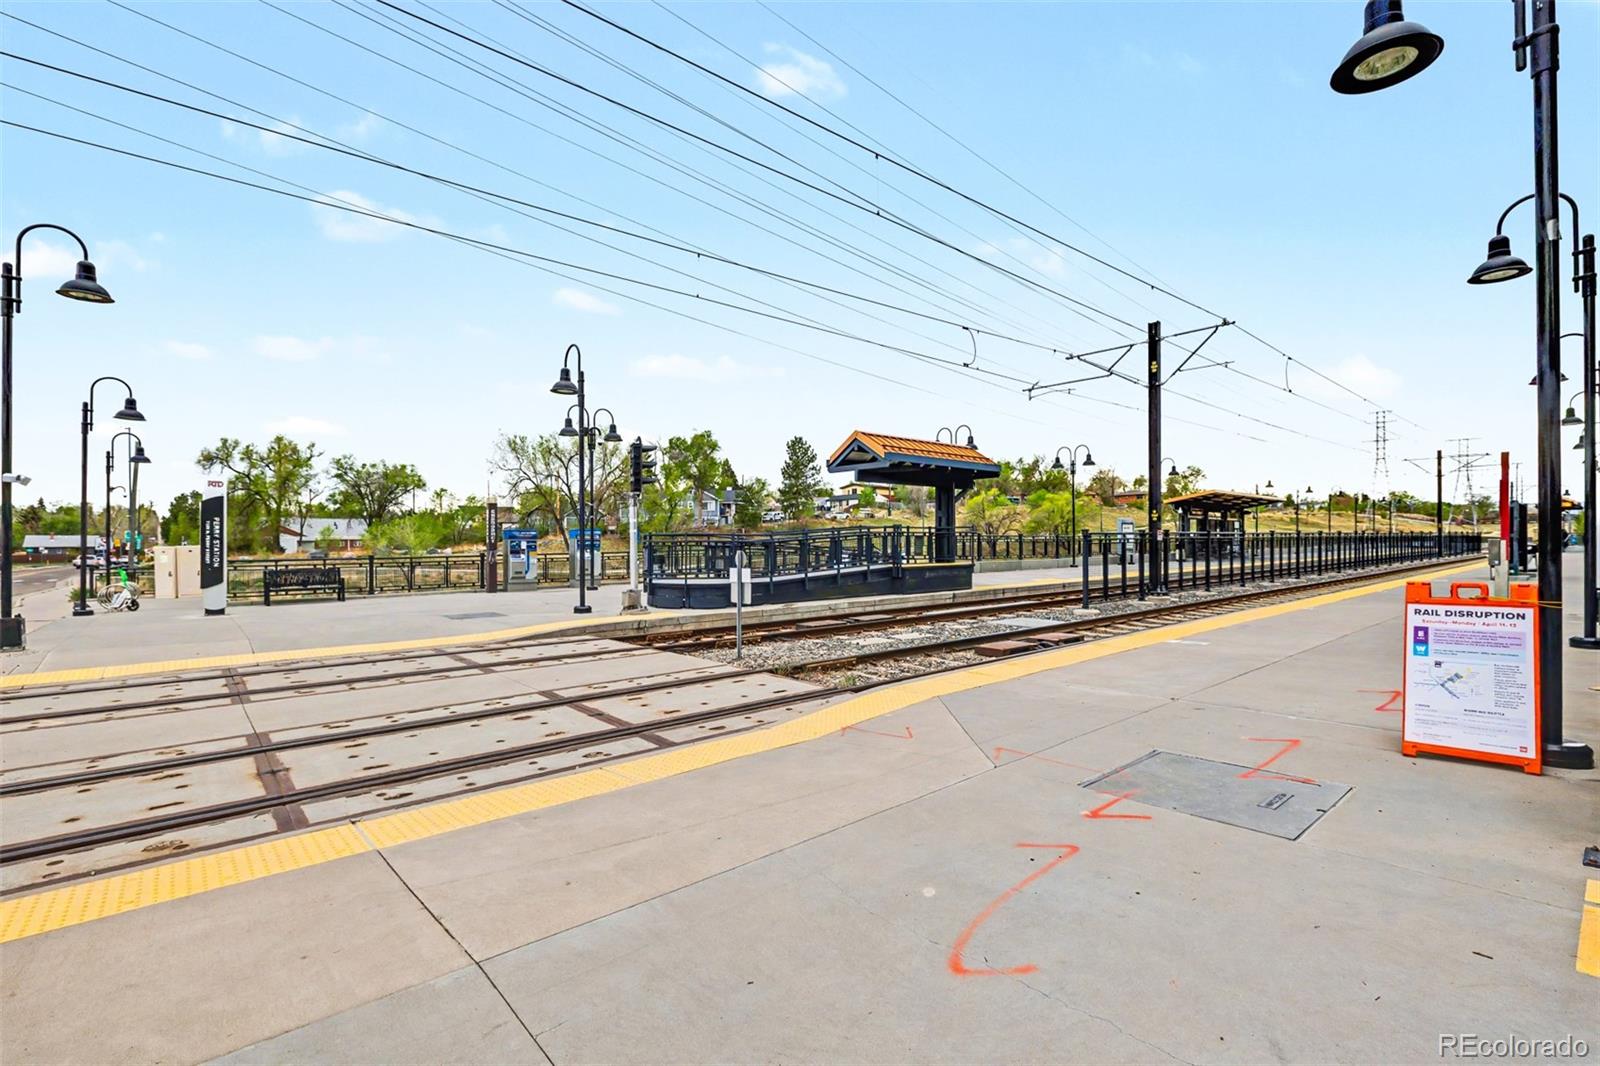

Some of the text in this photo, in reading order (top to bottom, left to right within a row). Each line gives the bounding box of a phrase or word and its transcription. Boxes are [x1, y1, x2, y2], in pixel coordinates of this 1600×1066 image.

[212, 539, 221, 568] STATION
[1413, 608, 1526, 621] RAIL DISRUPTION
